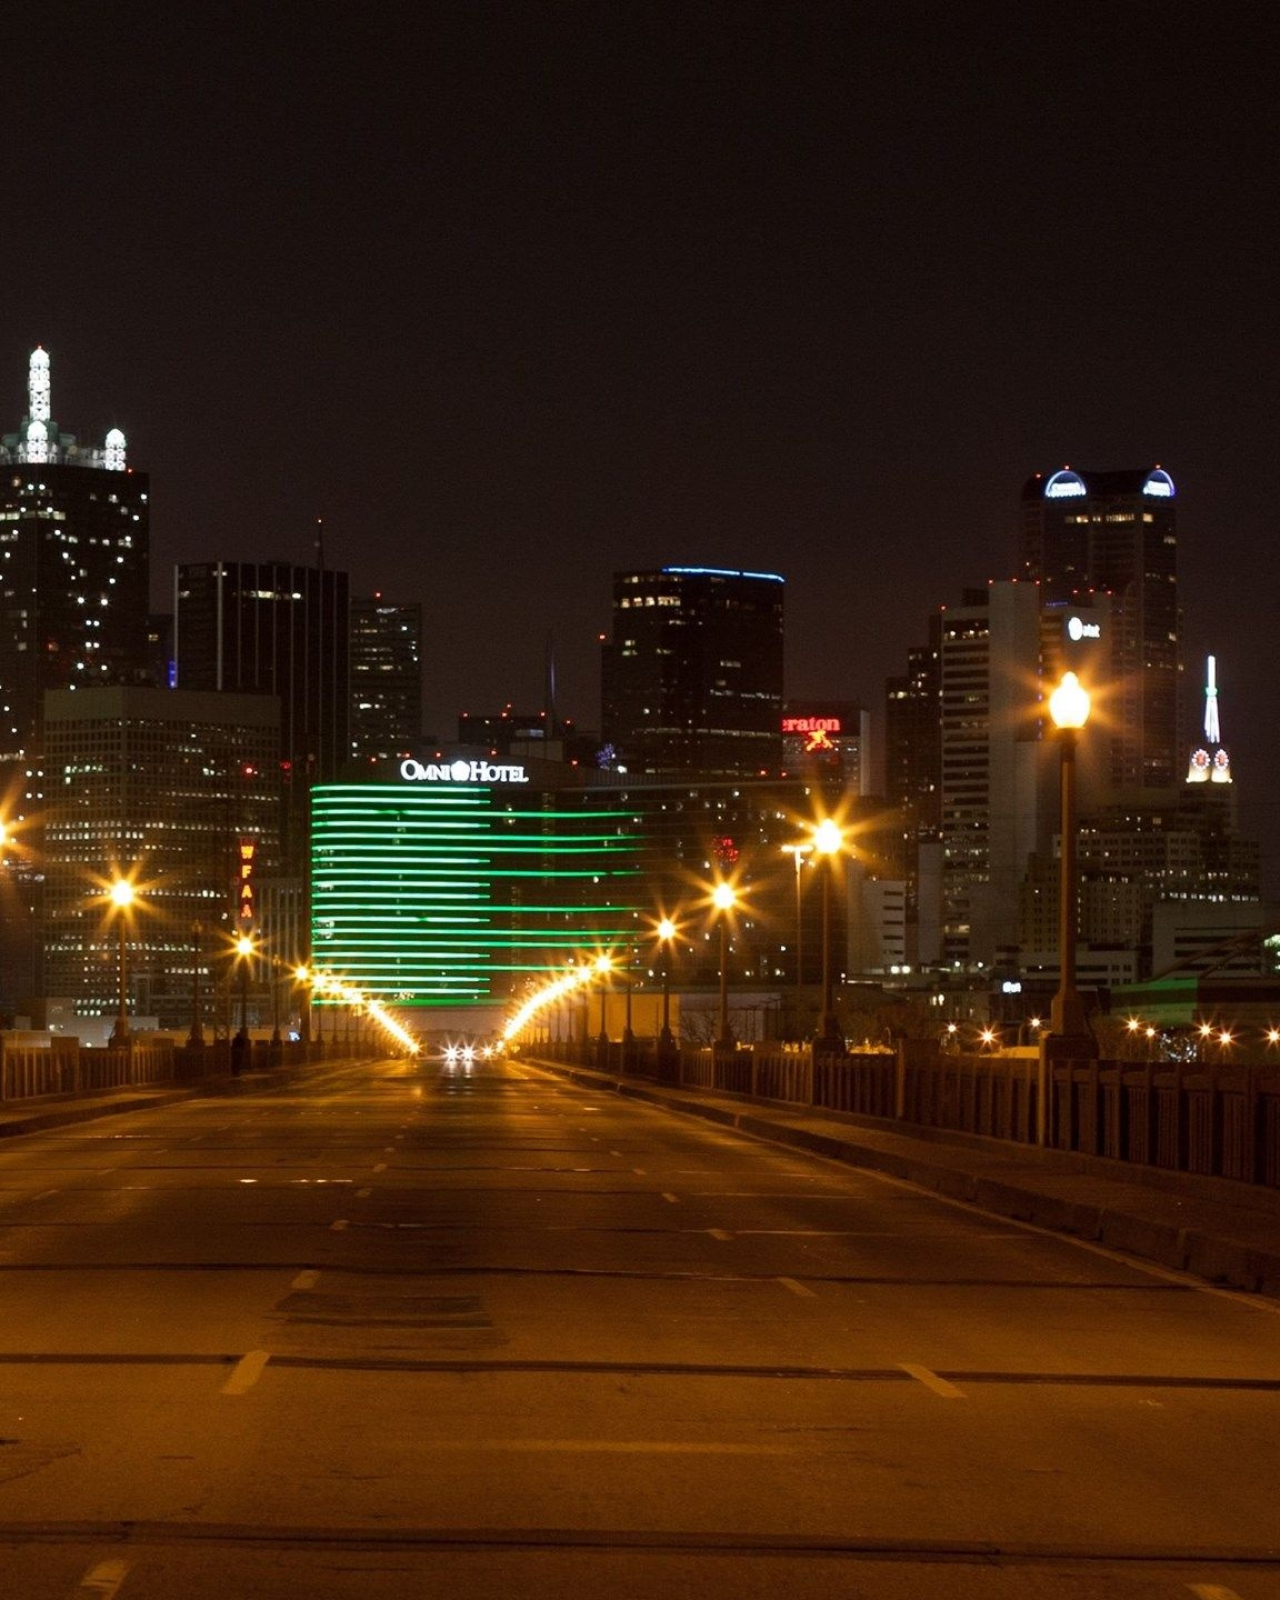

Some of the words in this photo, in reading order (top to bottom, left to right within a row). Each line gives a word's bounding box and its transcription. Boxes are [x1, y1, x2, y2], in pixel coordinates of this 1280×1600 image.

[400, 759, 452, 781] OMNI
[470, 761, 530, 782] HOTEL
[241, 845, 254, 917] WFAA
